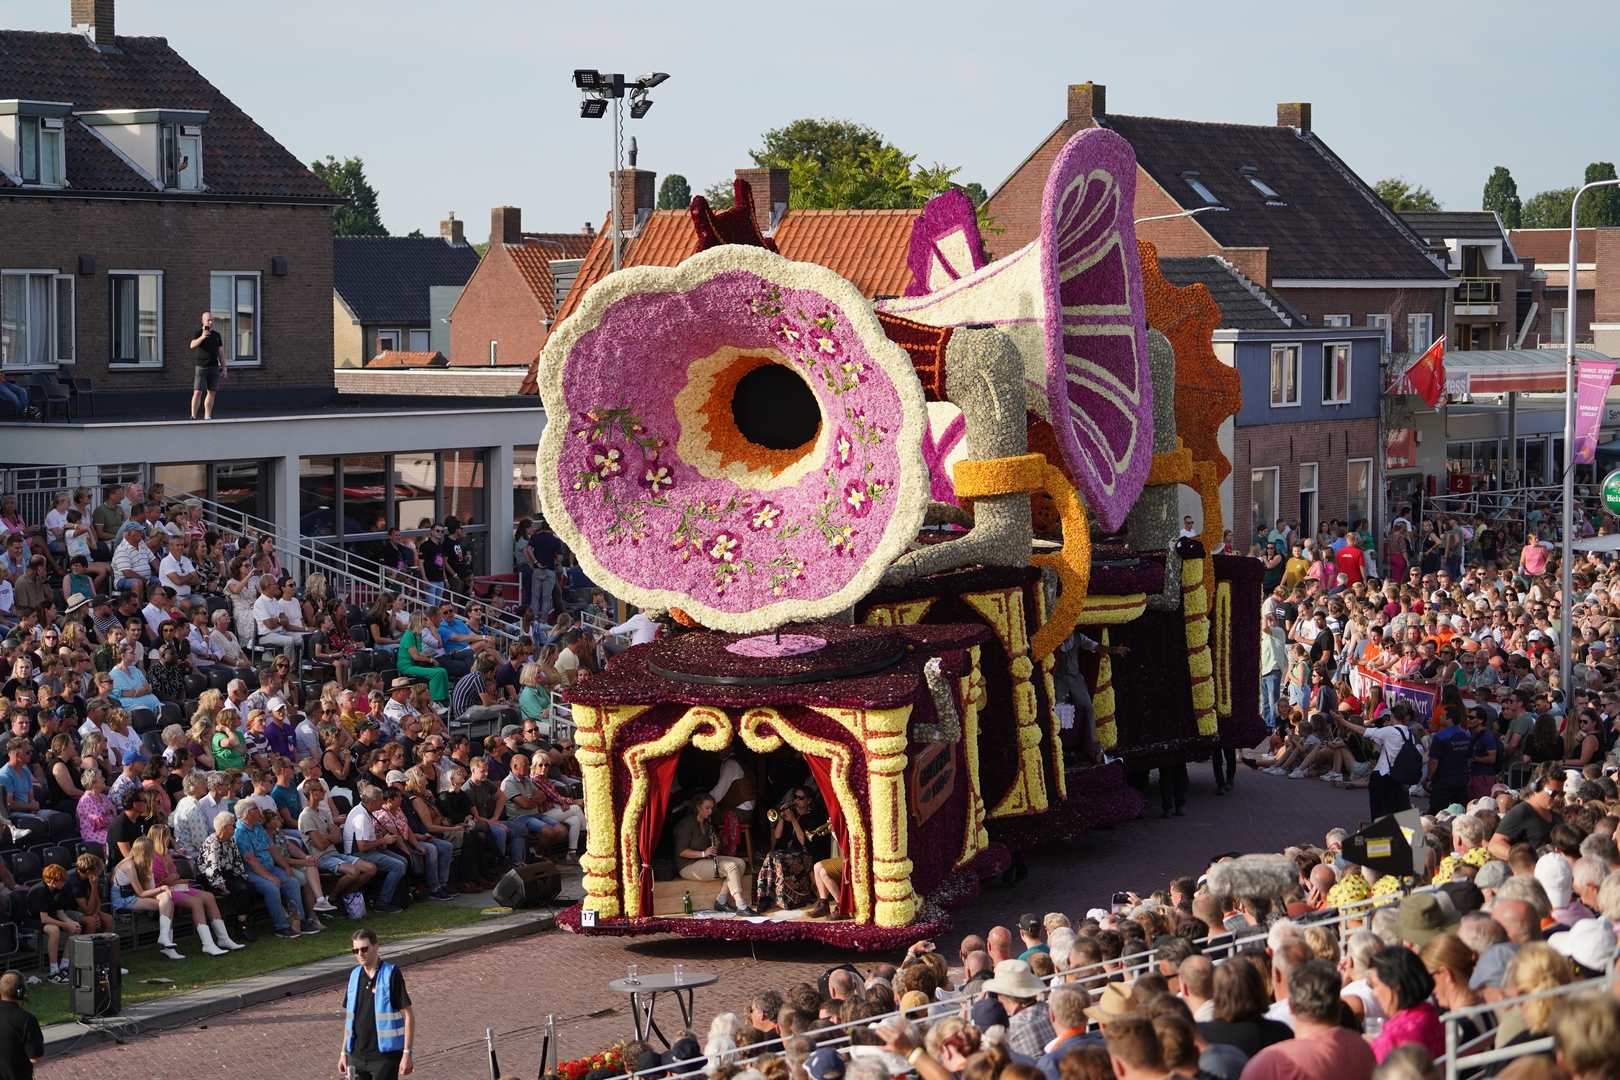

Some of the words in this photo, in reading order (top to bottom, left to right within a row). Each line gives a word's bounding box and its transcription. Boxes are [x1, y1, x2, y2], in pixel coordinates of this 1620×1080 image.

[1445, 379, 1466, 394] ress
[1456, 478, 1464, 488] 2
[583, 912, 594, 920] 17
